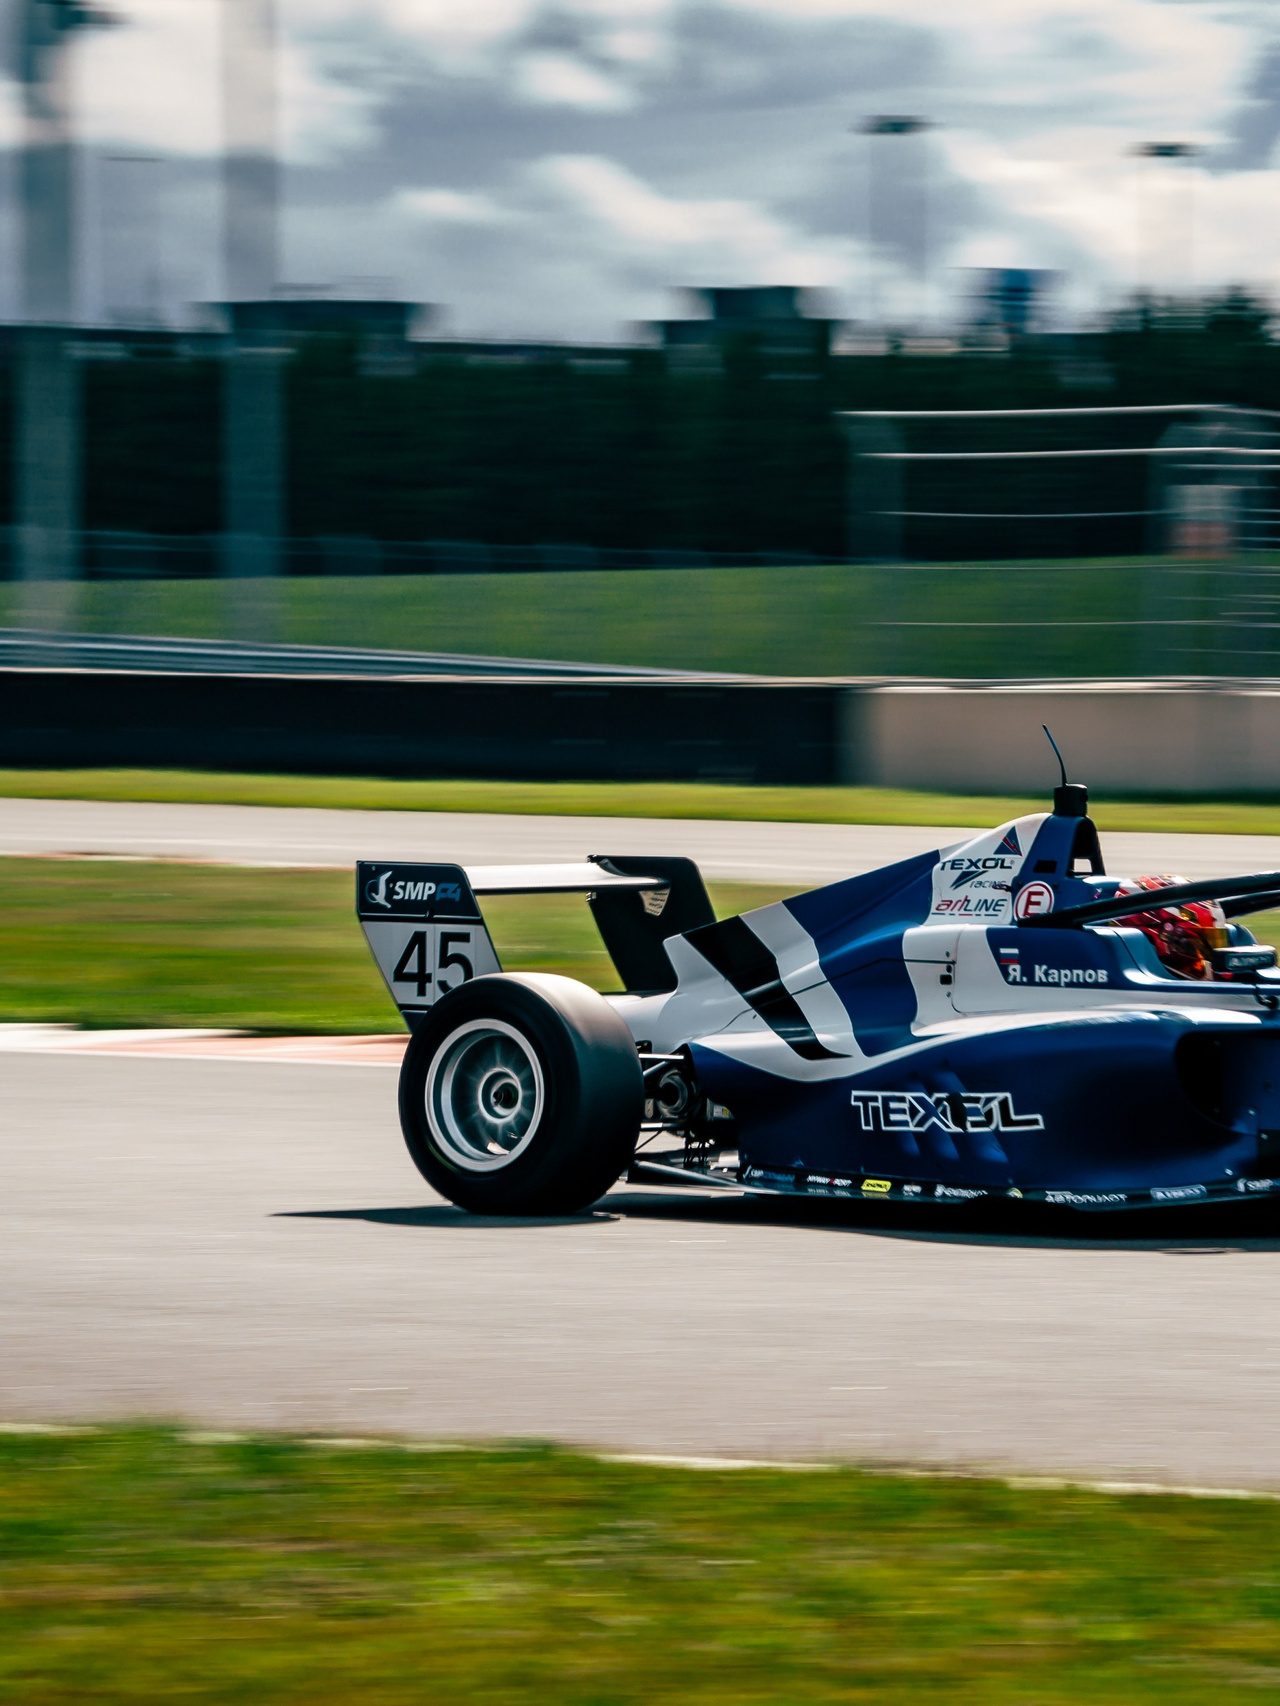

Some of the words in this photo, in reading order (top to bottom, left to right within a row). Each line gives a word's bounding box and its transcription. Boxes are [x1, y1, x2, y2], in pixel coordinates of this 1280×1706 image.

[940, 857, 1013, 871] TEXOL
[392, 881, 437, 901] SMP
[392, 930, 474, 997] 45
[1007, 964, 1028, 983] Я.
[1034, 964, 1109, 987] Карпов
